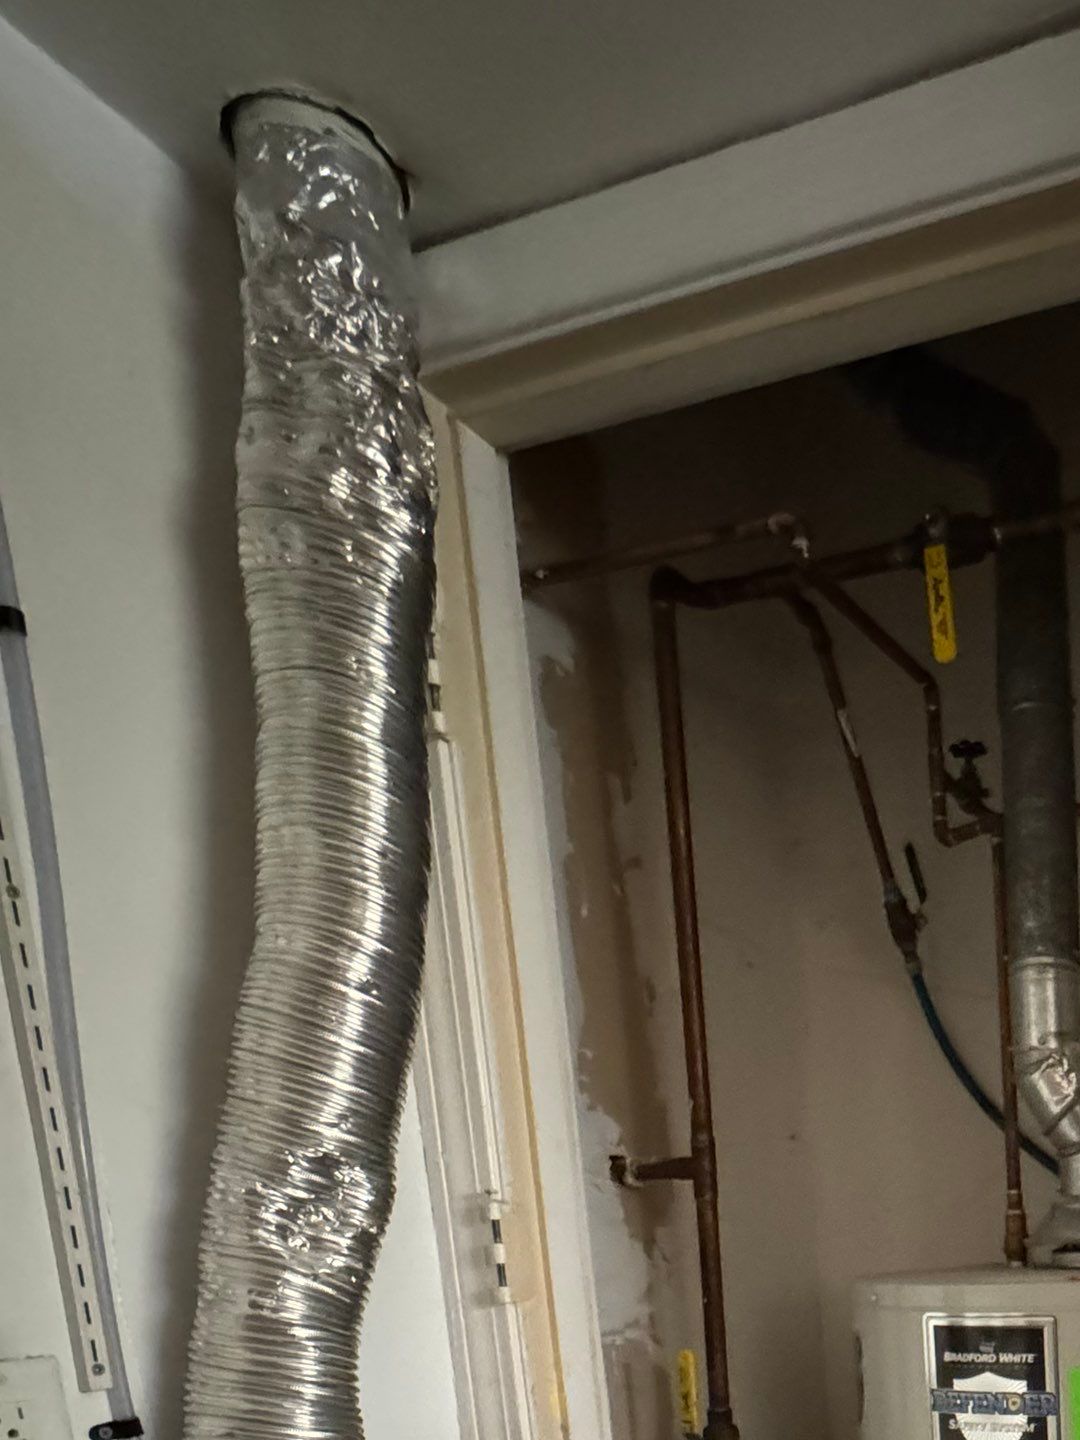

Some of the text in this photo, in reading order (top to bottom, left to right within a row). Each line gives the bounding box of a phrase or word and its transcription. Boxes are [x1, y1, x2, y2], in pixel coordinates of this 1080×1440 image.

[944, 1351, 1035, 1363] BRADFORD WHITE
[932, 1389, 1058, 1417] DEFENDER
